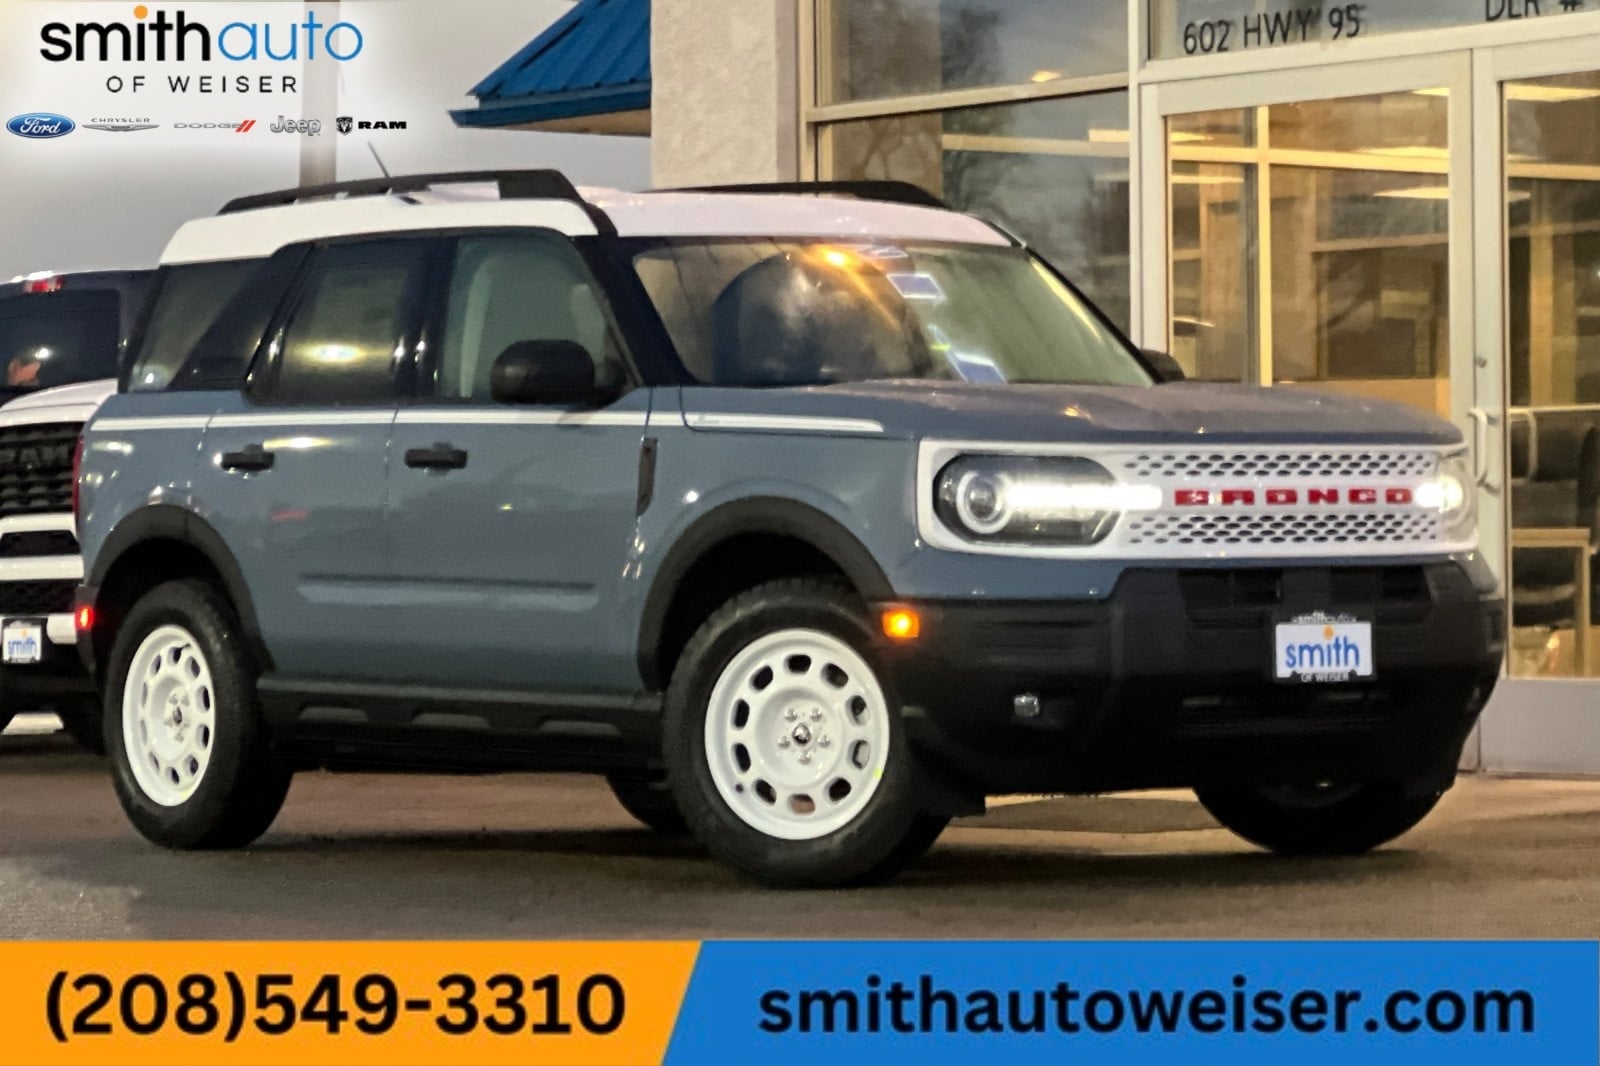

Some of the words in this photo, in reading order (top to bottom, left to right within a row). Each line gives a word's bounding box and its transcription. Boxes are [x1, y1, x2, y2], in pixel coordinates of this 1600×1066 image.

[1184, 19, 1231, 54] 602
[1243, 8, 1314, 48] HWY
[1328, 4, 1365, 40] 95
[1174, 488, 1413, 506] BRONCO
[1285, 624, 1360, 668] smith
